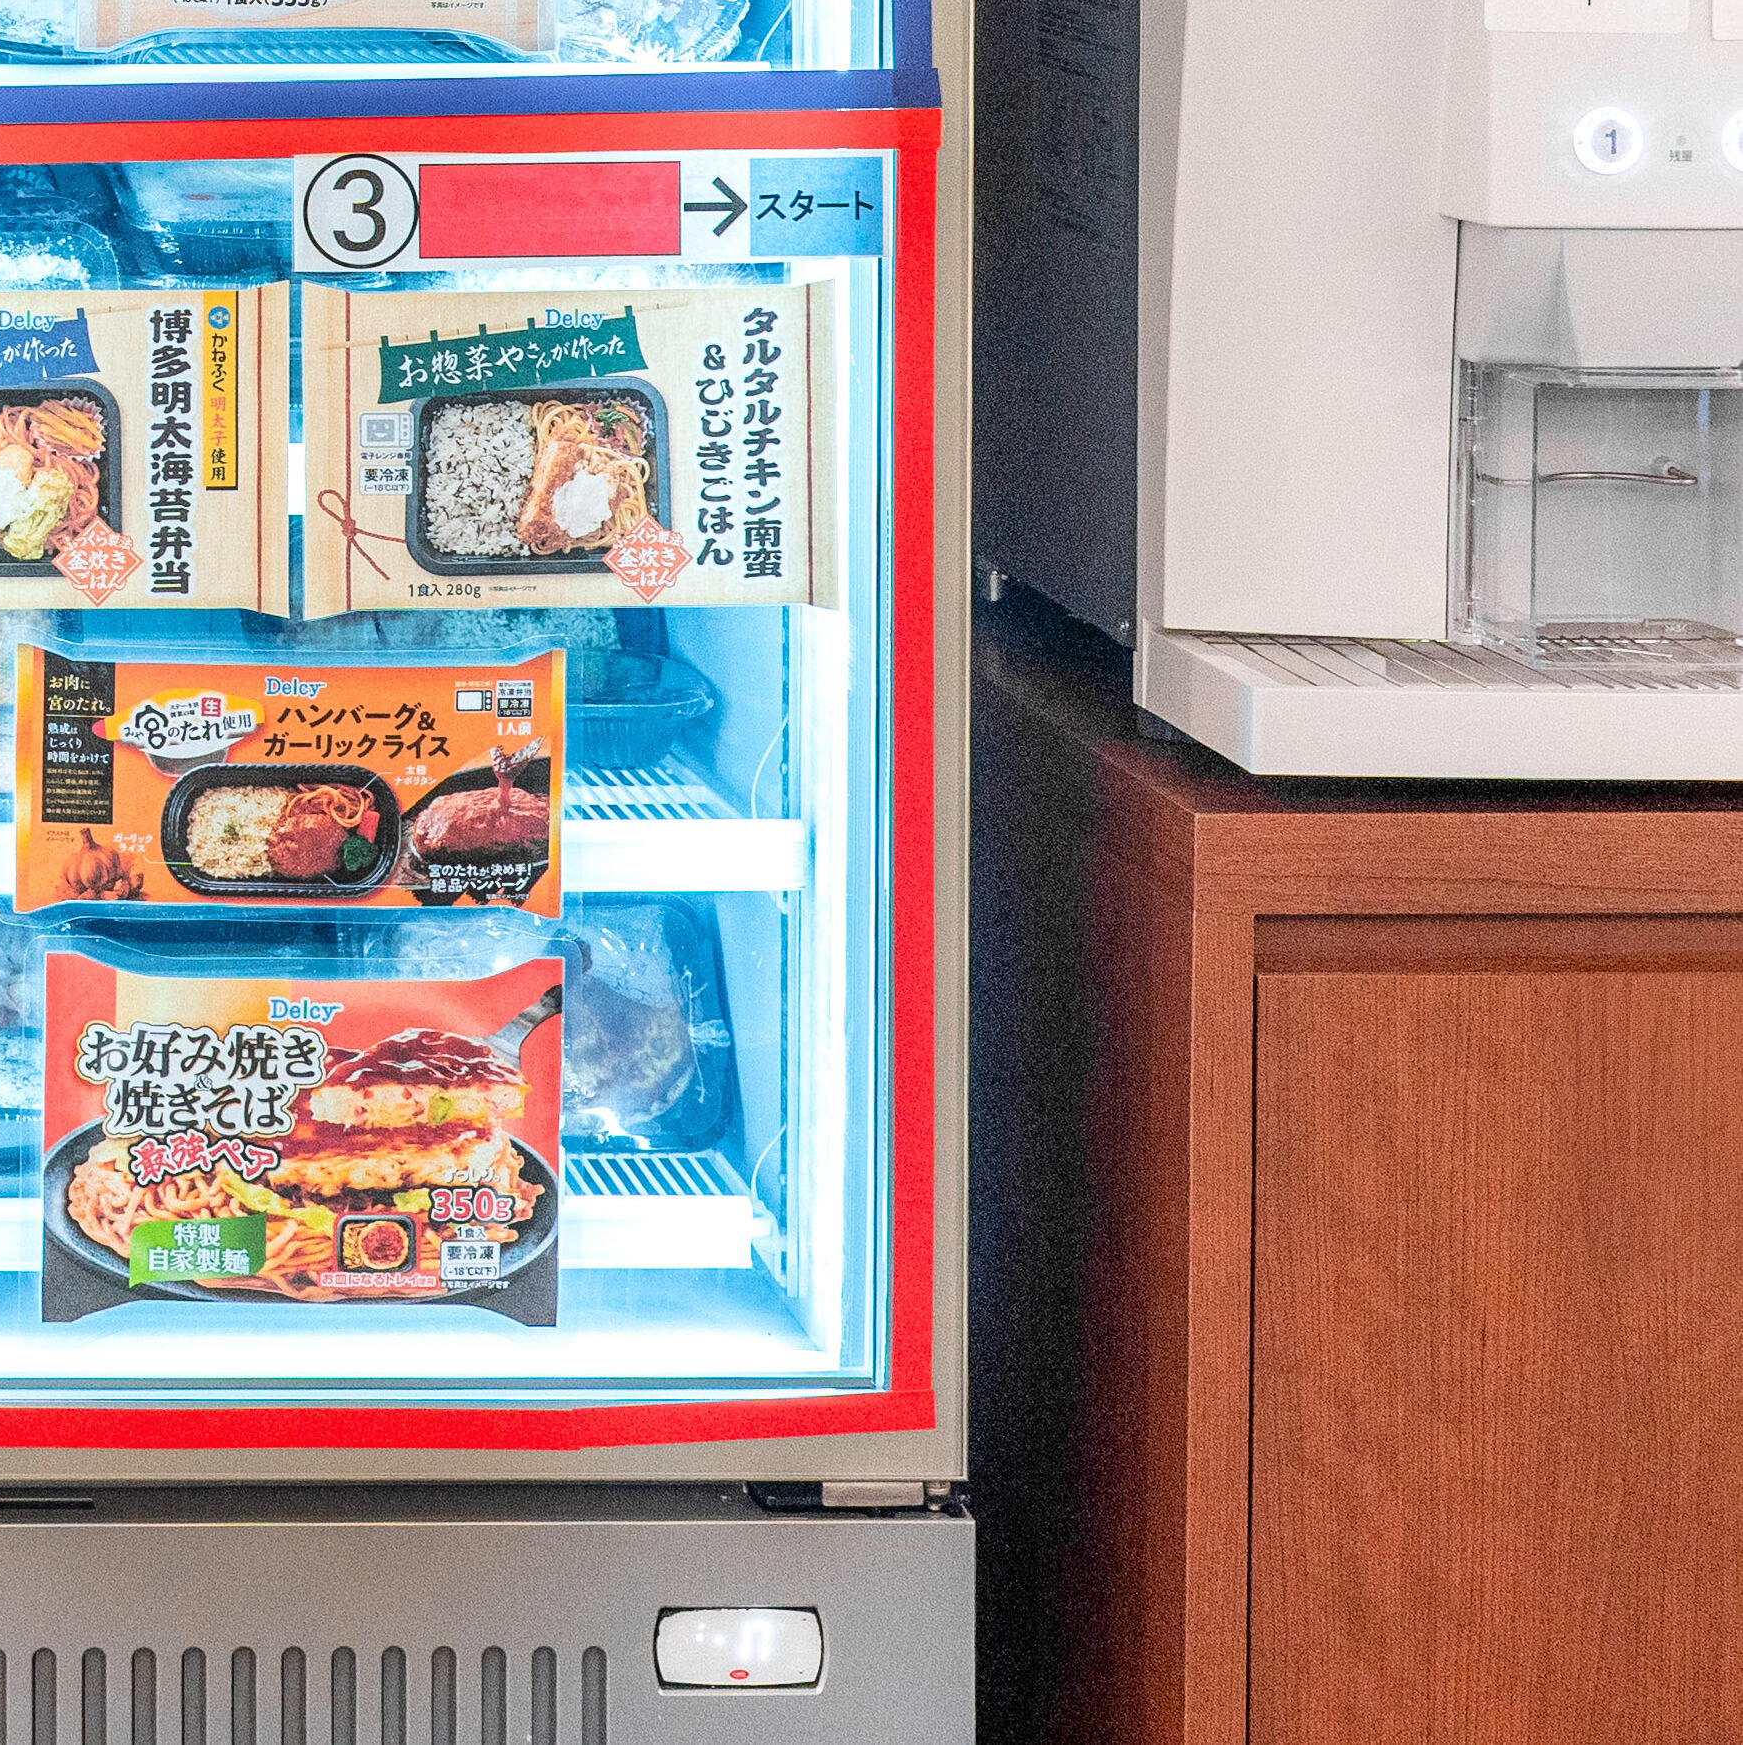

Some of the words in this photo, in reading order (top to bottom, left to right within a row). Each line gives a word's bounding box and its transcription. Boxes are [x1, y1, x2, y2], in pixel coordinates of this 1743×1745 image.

[1604, 128, 1618, 155] 1
[755, 189, 876, 224] スタート
[545, 308, 606, 330] Delcy
[398, 334, 627, 389] お惣菜やさんが作った
[149, 308, 194, 595] 博多明太海苔弁当
[695, 343, 735, 567] &ひじきごはん
[743, 307, 783, 579] タルタルチキン南蛮
[363, 467, 410, 482] 要冷凍
[67, 550, 128, 572] 釜炊き
[617, 547, 677, 570] 釜炊き
[71, 571, 127, 591] ごはん
[447, 583, 482, 599] 280g
[621, 568, 678, 589] ごはん
[48, 674, 91, 691] お肉に
[265, 677, 326, 698] Delcy
[276, 701, 437, 732] ハンバーグ&
[496, 721, 532, 737] 1人前
[46, 750, 111, 764] 時間をかけて
[263, 732, 451, 760] ガーリックライス
[431, 876, 531, 894] 絶品ハンバーグ
[270, 998, 341, 1023] Delcy
[84, 1027, 317, 1080] お好み焼き
[112, 1082, 287, 1132] 焼きそば
[130, 1134, 279, 1184] 最強ペア
[432, 1189, 513, 1220] 350g
[173, 1222, 222, 1248] 特製
[456, 1226, 487, 1240] 1食入
[148, 1246, 250, 1274] 自家製麺
[446, 1245, 495, 1261] 要冷凍
